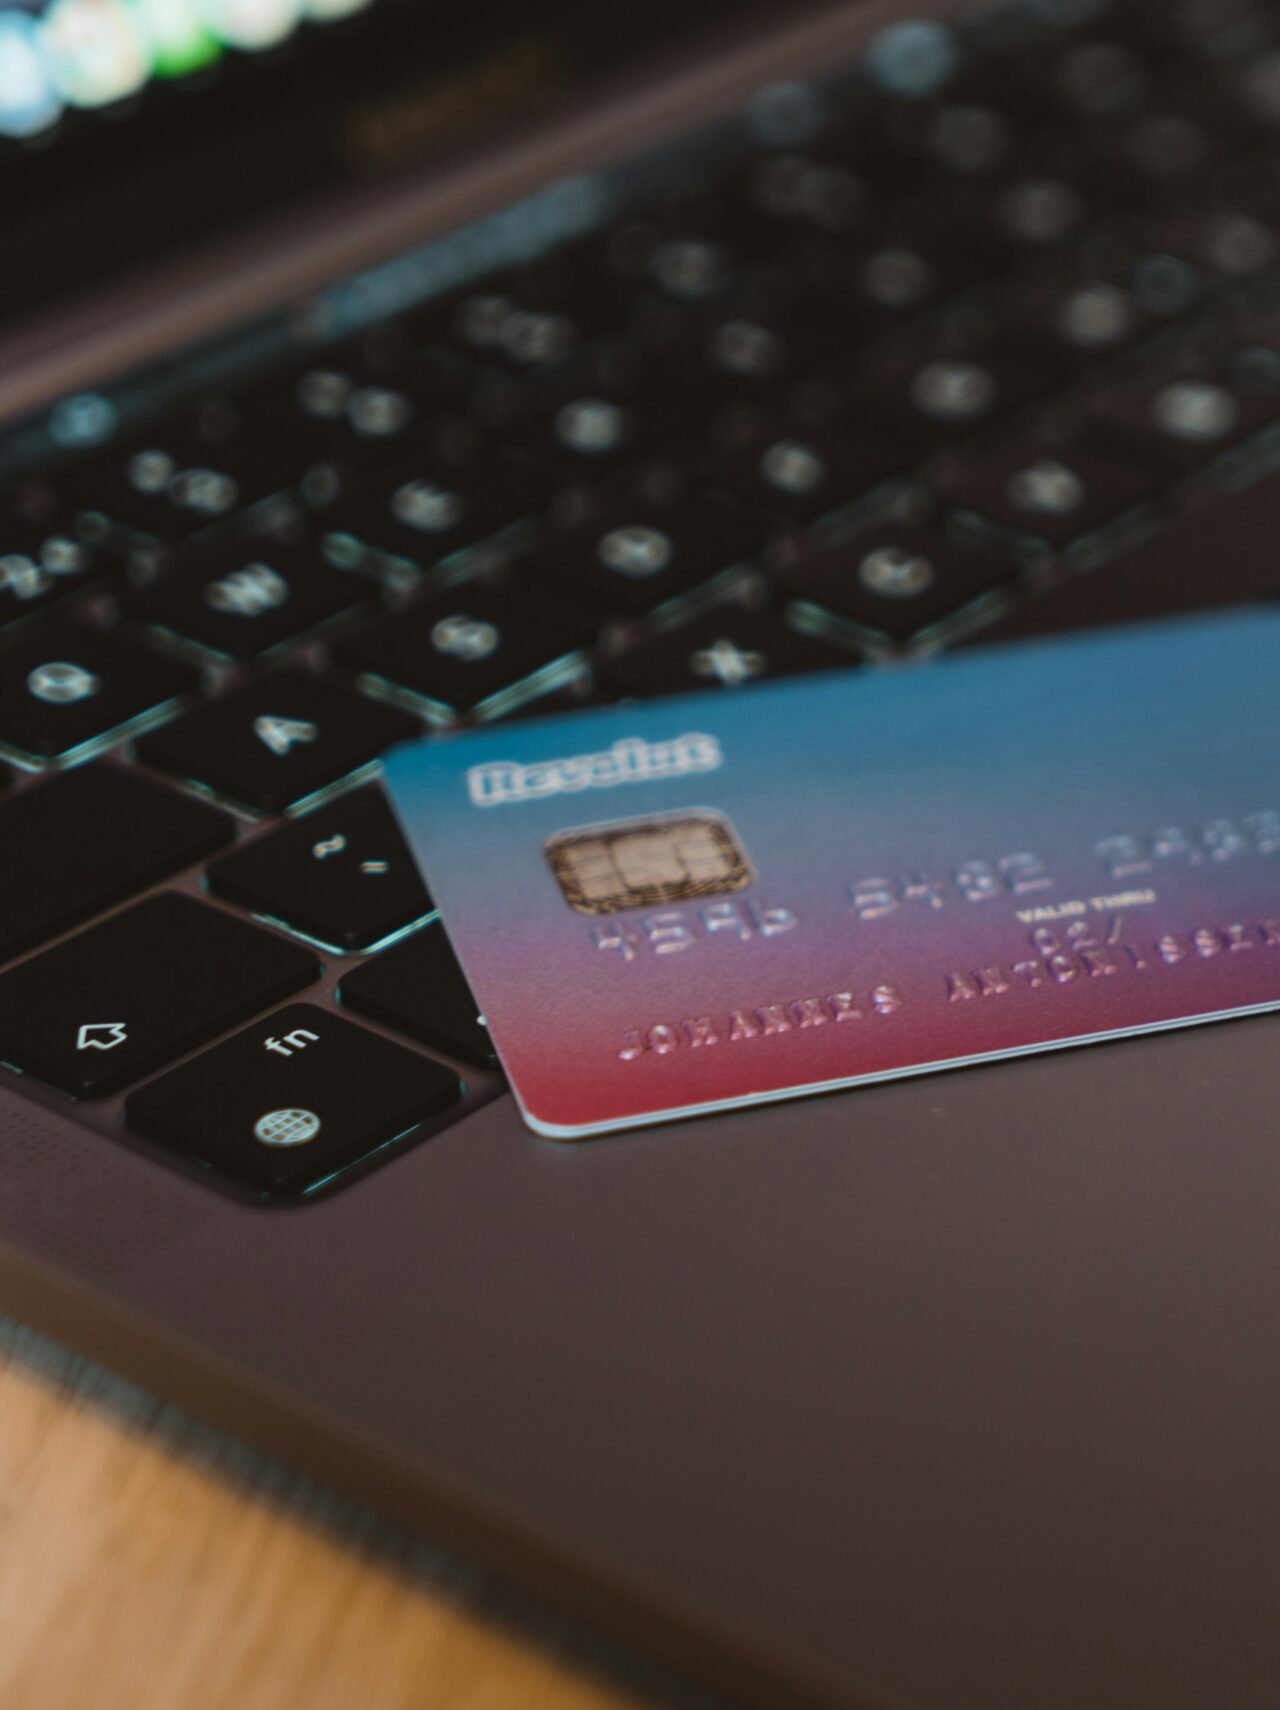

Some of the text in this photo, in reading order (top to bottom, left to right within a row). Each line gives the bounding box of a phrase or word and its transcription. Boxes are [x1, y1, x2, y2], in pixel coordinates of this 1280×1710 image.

[1015, 887, 1157, 925] VALID THRU
[617, 983, 904, 1062] JOHANNES
[263, 1027, 320, 1058] fn
